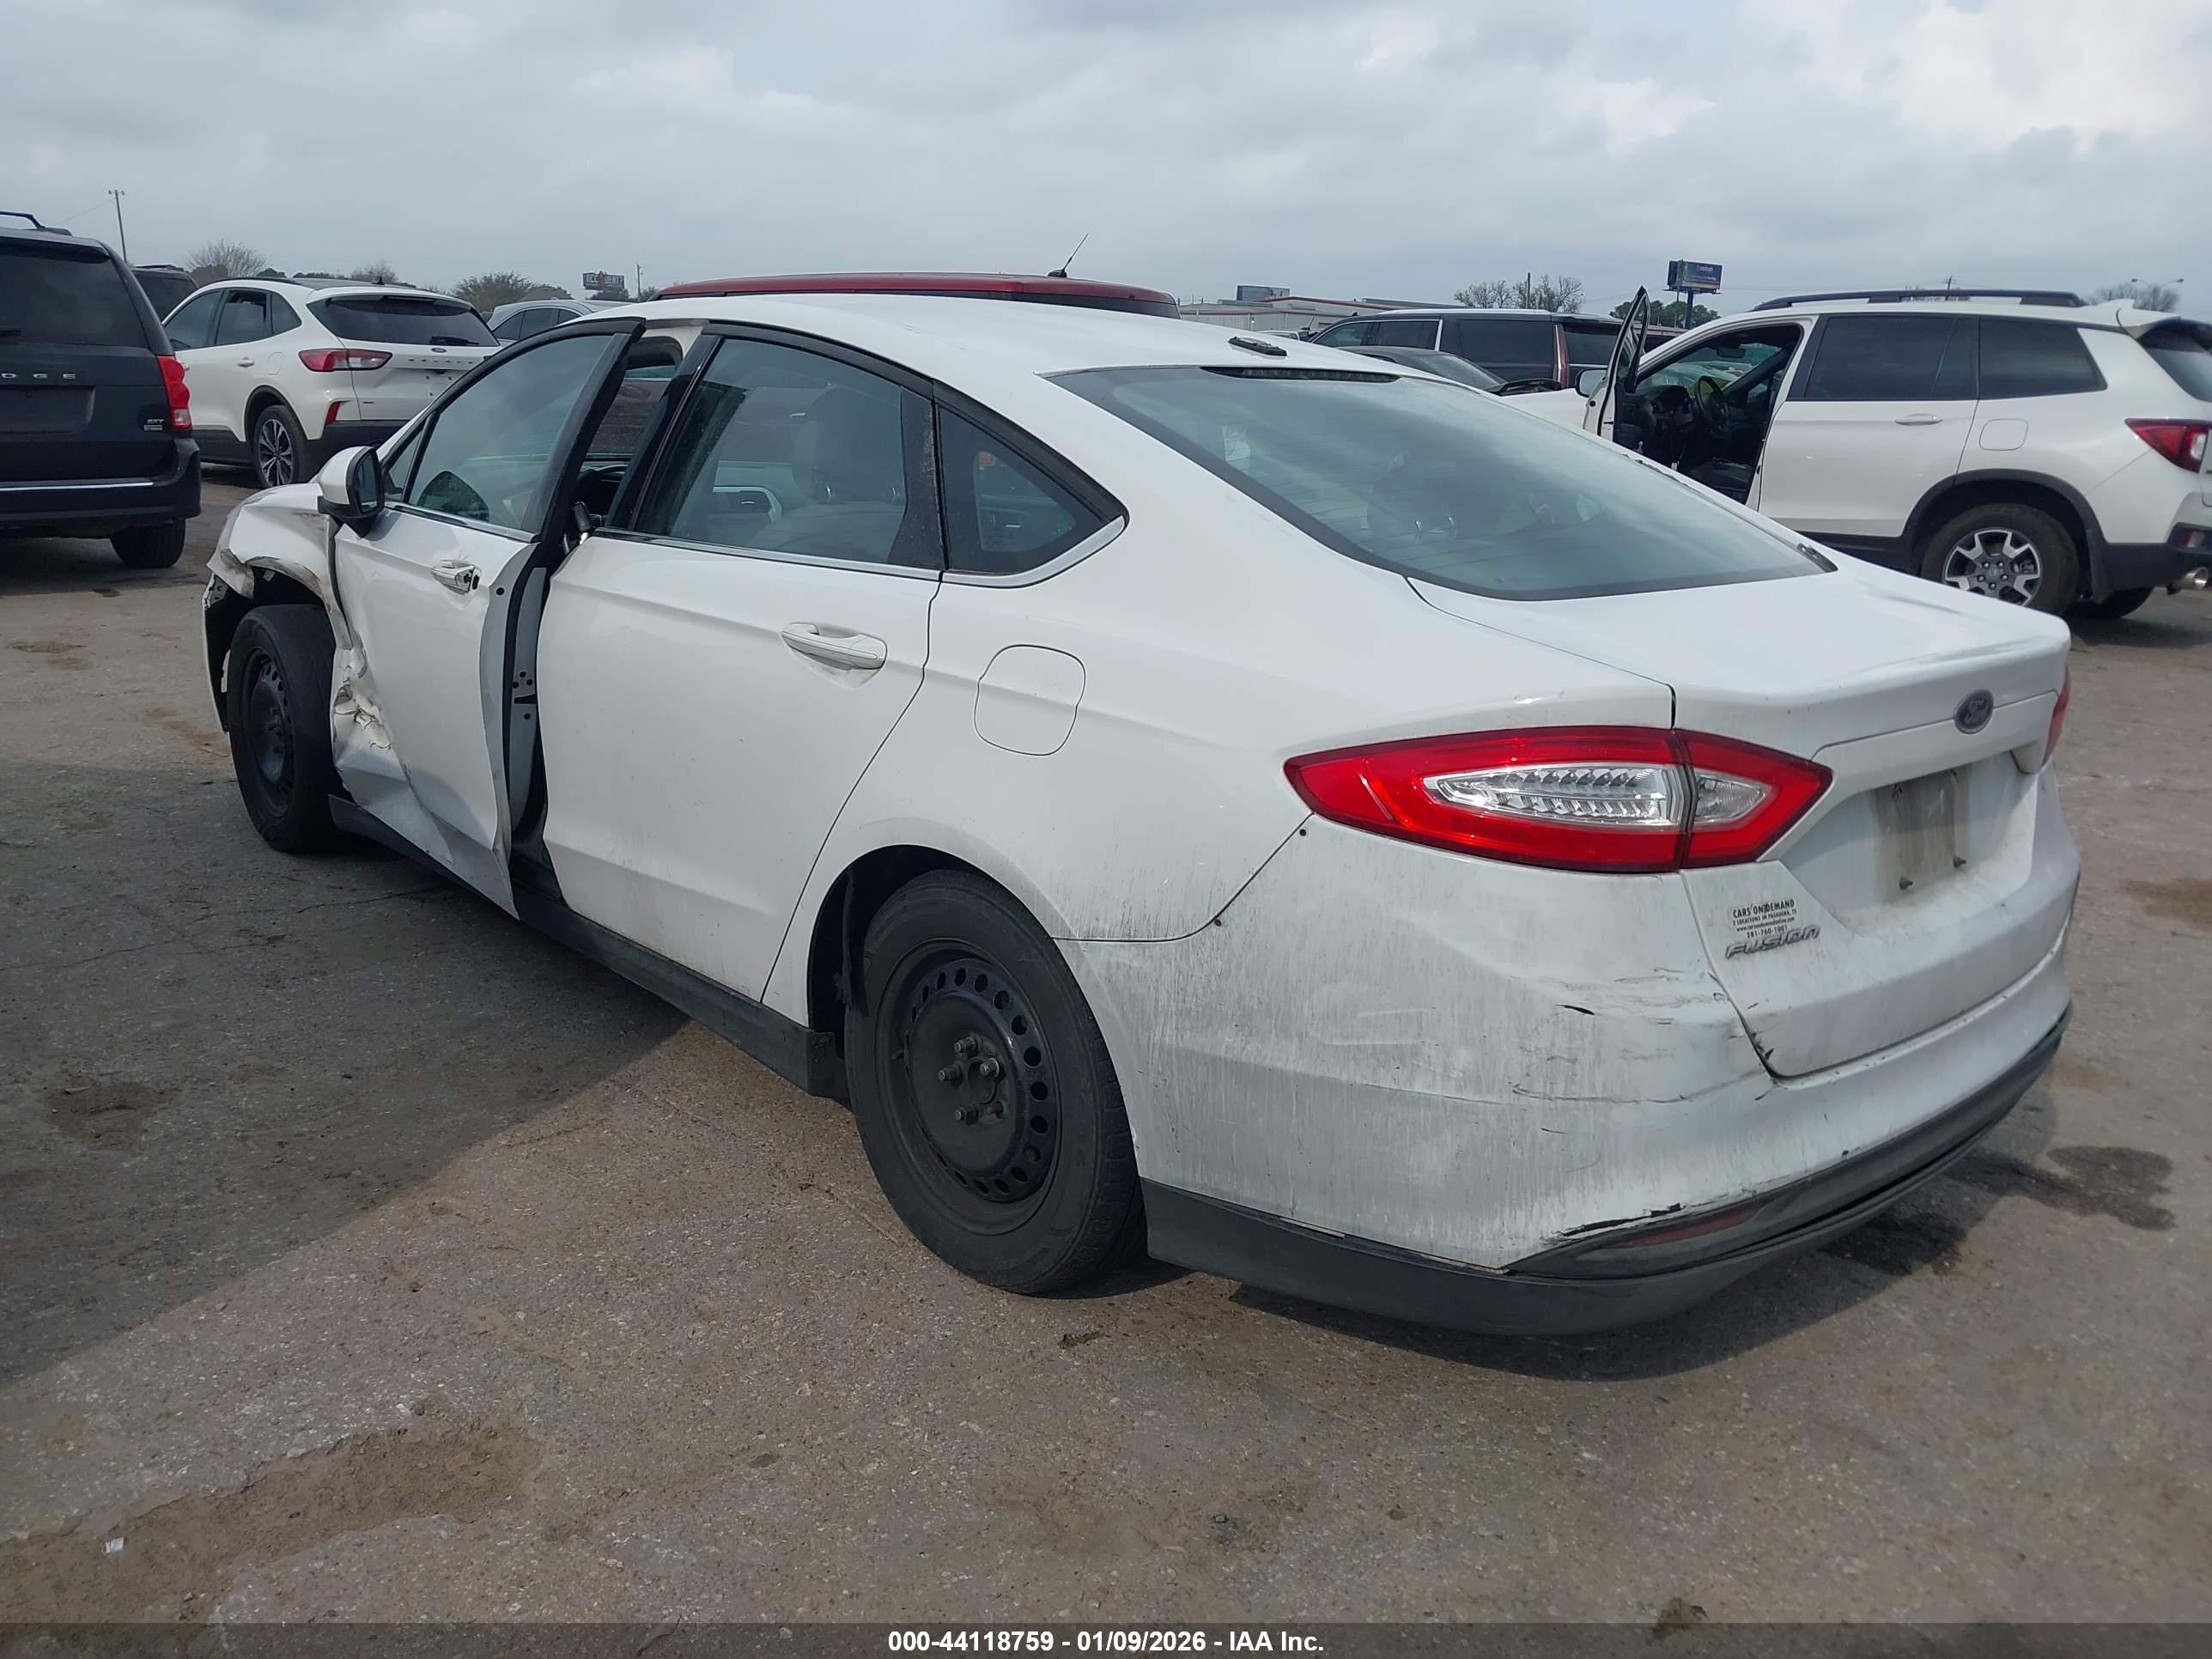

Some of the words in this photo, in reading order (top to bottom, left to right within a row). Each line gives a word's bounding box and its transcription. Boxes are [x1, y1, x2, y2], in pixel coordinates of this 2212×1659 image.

[1733, 907, 1752, 918] CARS
[1753, 904, 1765, 915] ON
[1765, 899, 1795, 913] DEMAND
[1736, 915, 1761, 926] LOCATIONS
